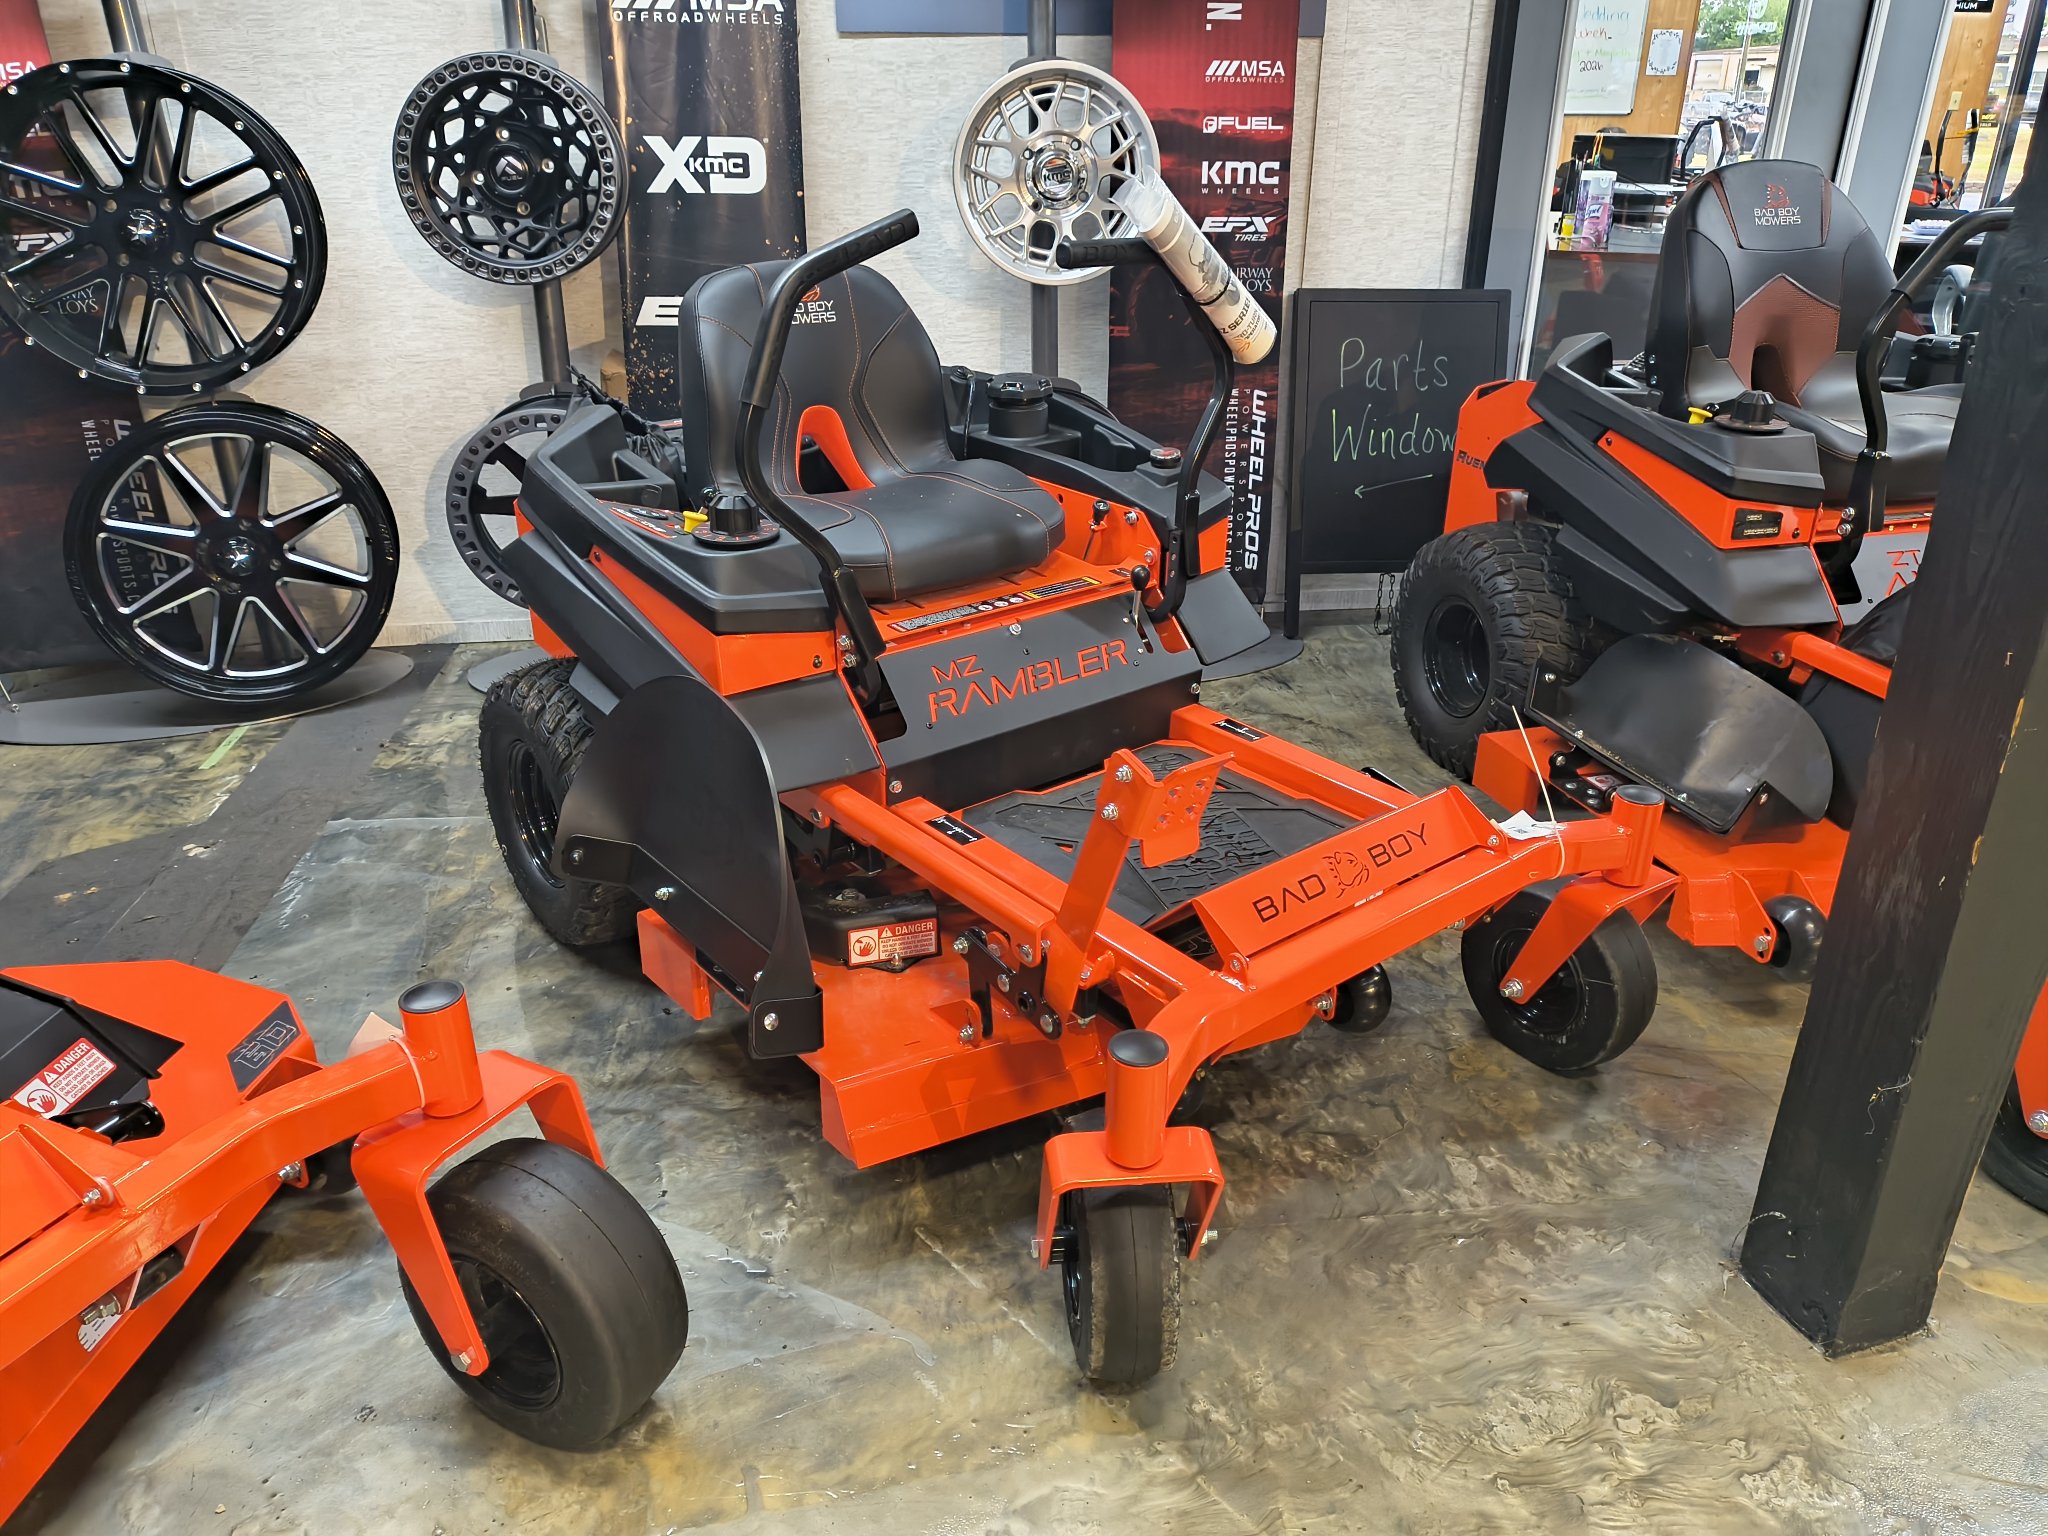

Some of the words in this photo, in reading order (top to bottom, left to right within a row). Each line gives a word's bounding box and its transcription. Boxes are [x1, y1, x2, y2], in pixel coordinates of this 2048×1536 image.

[613, 11, 783, 25] OFFROADWHEELS
[1217, 116, 1284, 130] FUEL
[1201, 187, 1279, 195] WHEELS
[1753, 207, 1775, 217] BAD
[1778, 206, 1800, 216] BOY
[1200, 216, 1277, 233] EFX
[1755, 215, 1801, 226] MOWERS
[1234, 233, 1269, 242] TIRES
[808, 300, 834, 313] BOY
[1340, 336, 1449, 392] Parts
[1331, 403, 1457, 462] Window
[931, 653, 985, 685] MZ
[928, 638, 1129, 724] RAMBLER
[1252, 873, 1327, 923] BAD
[1366, 822, 1428, 868] BOY
[895, 922, 933, 935] DANGER
[53, 1042, 90, 1072] DANGER
